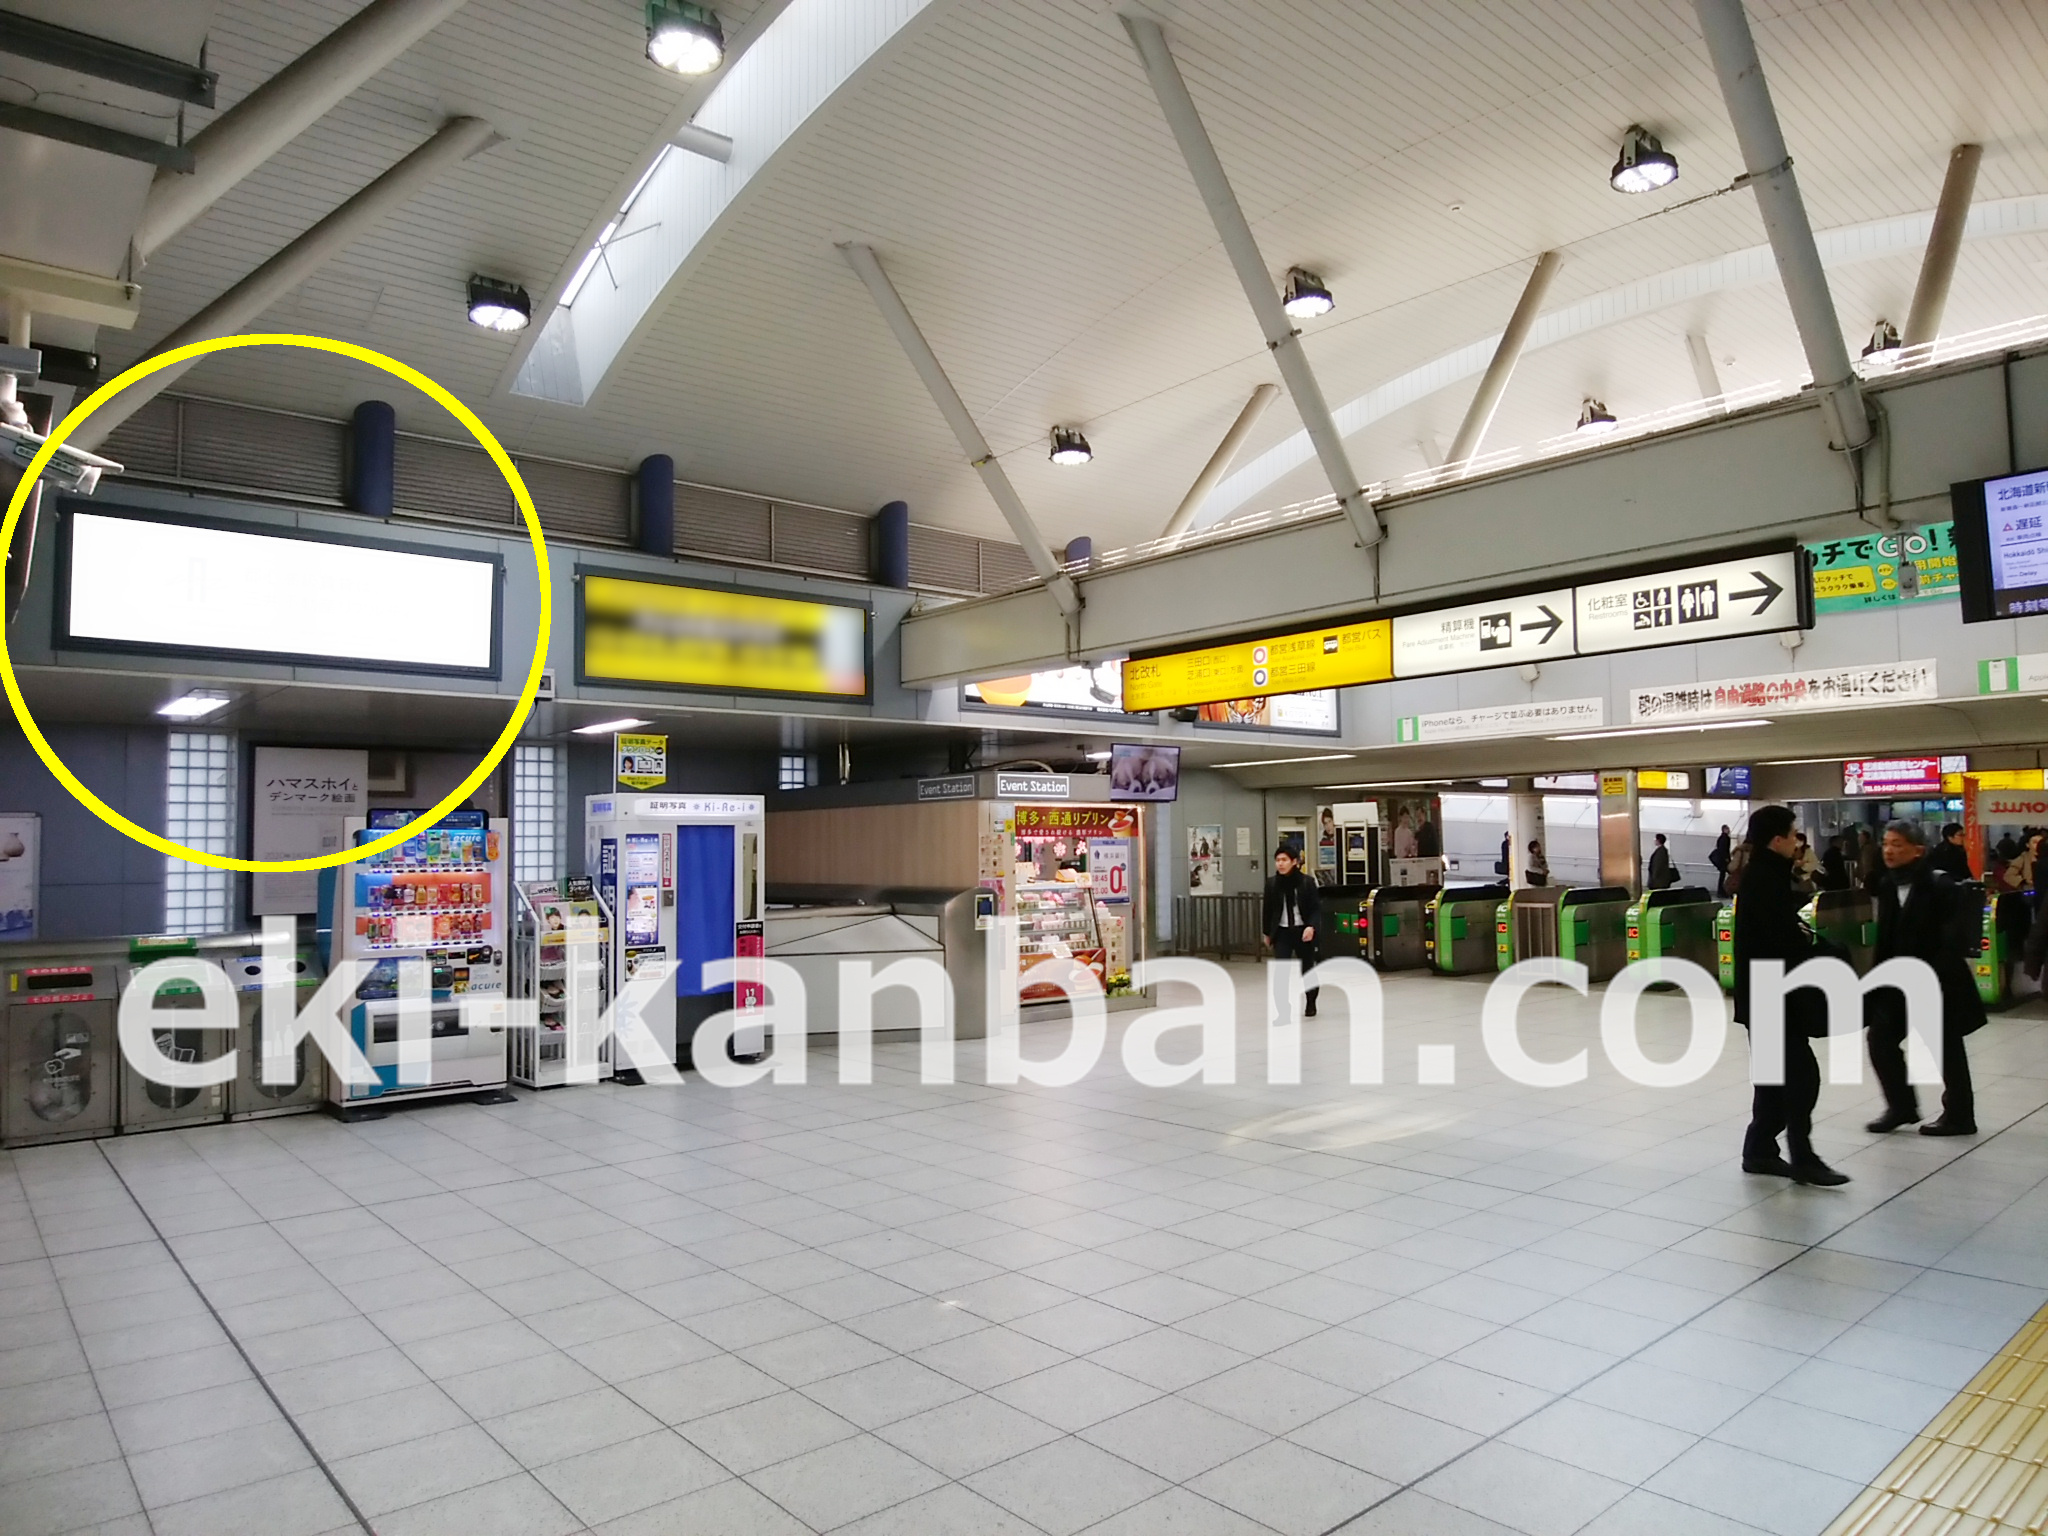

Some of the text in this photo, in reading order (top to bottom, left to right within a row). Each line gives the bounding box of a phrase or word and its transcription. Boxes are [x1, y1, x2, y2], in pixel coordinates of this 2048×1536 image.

[1997, 481, 2048, 502] 北海道新
[1587, 592, 1628, 612] 化粧室
[1588, 607, 1629, 622] Restrooms
[1440, 617, 1475, 634] 精算機
[1341, 628, 1382, 645] 都営バス
[1270, 638, 1316, 656] 都営浅草線
[1129, 664, 1161, 681] 北改札
[1270, 661, 1317, 679] 都営三田線
[266, 777, 359, 792] ハマスホイと
[919, 781, 973, 796] Event Station
[1000, 779, 1067, 793] Event Station
[269, 791, 356, 803] デンマーク絵画
[649, 801, 687, 810] 証明写真
[1016, 809, 1110, 826] 博多・西通りプリン
[1498, 923, 1508, 932] IC
[1628, 927, 1639, 938] IC
[1720, 930, 1731, 941] IC
[470, 980, 502, 992] acure
